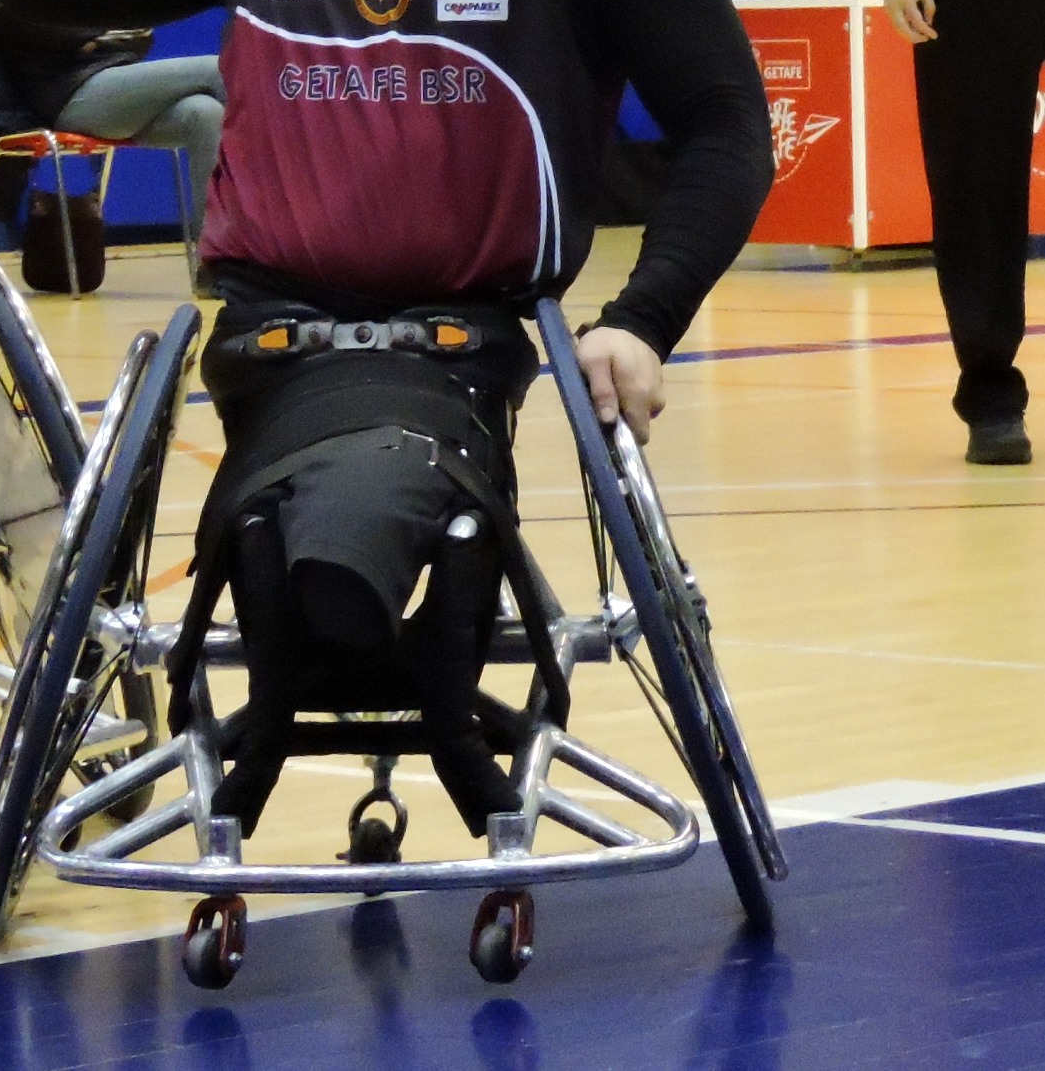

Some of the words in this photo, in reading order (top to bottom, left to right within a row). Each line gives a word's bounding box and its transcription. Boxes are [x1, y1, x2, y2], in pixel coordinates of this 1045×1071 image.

[279, 63, 406, 102] GETAFE
[420, 65, 488, 104] BSR
[764, 66, 802, 79] GETAFE
